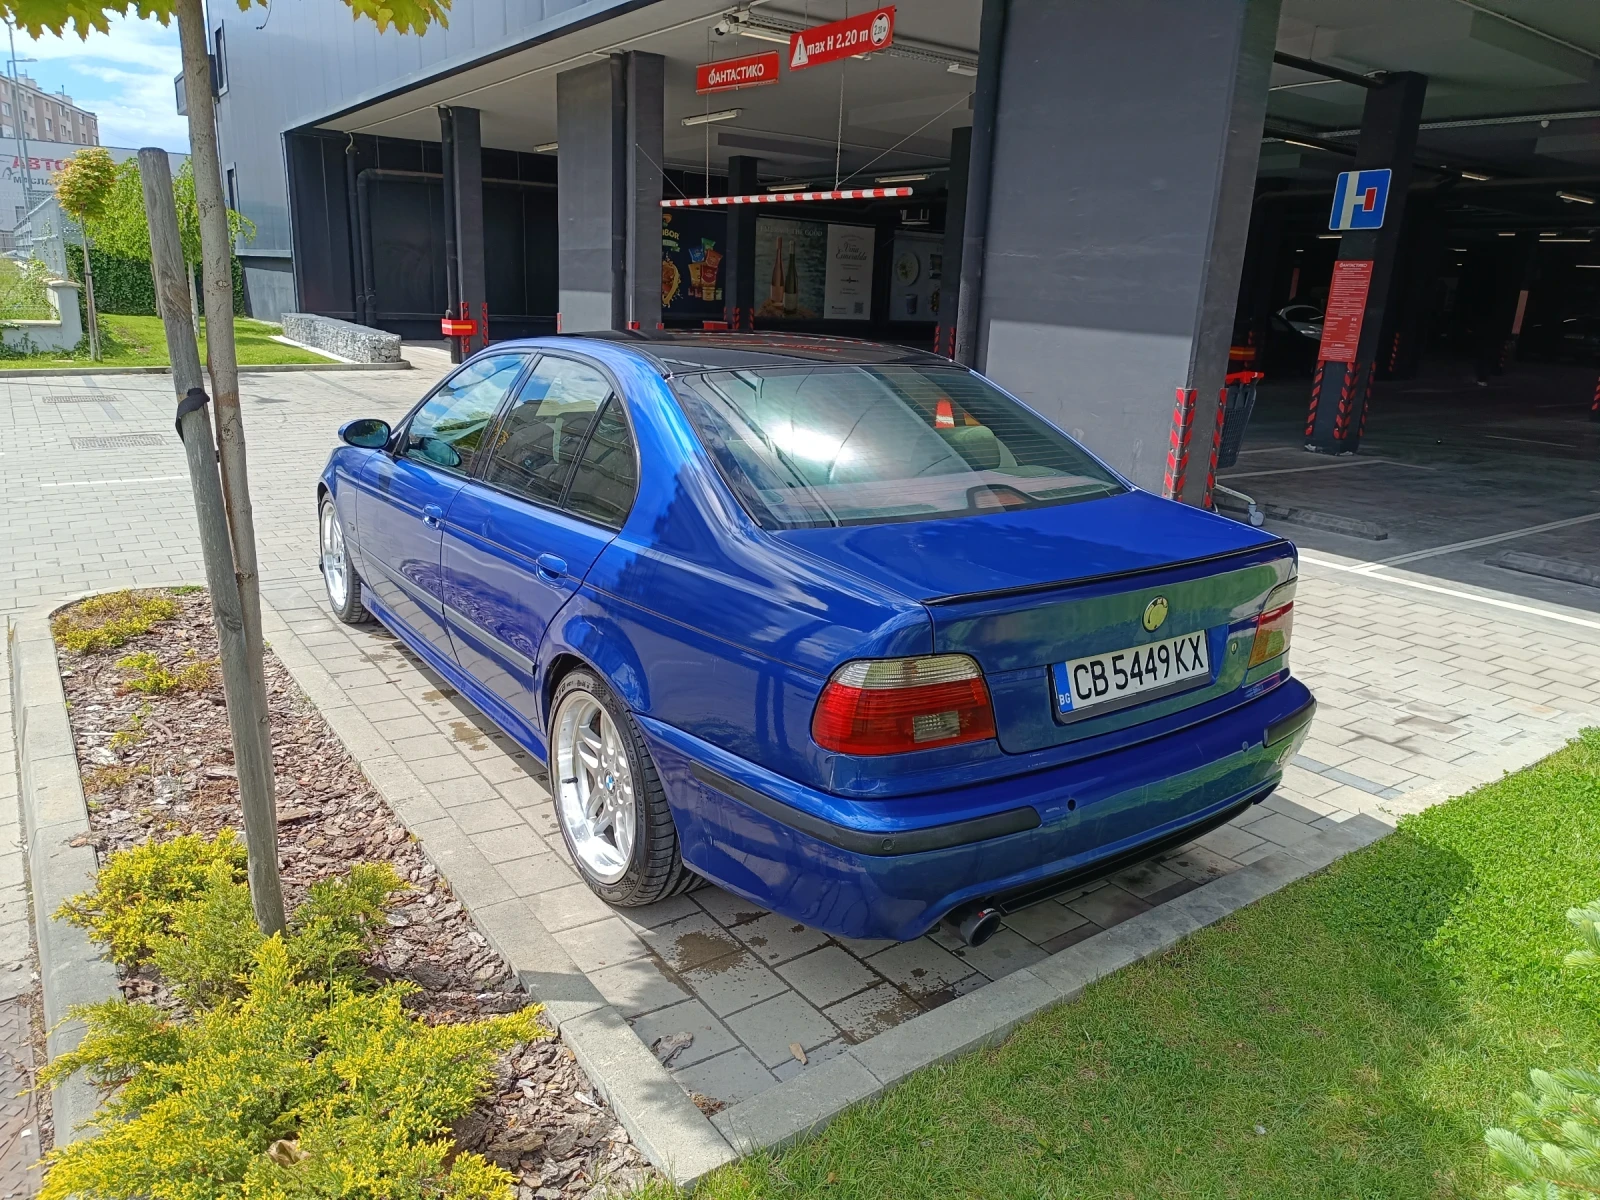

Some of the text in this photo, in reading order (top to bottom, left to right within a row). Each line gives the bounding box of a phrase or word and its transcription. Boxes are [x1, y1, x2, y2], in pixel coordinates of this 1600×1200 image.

[807, 28, 869, 56] max H 2.20 m
[708, 63, 765, 85] ФАНТАСТИКО
[1058, 693, 1071, 706] BG
